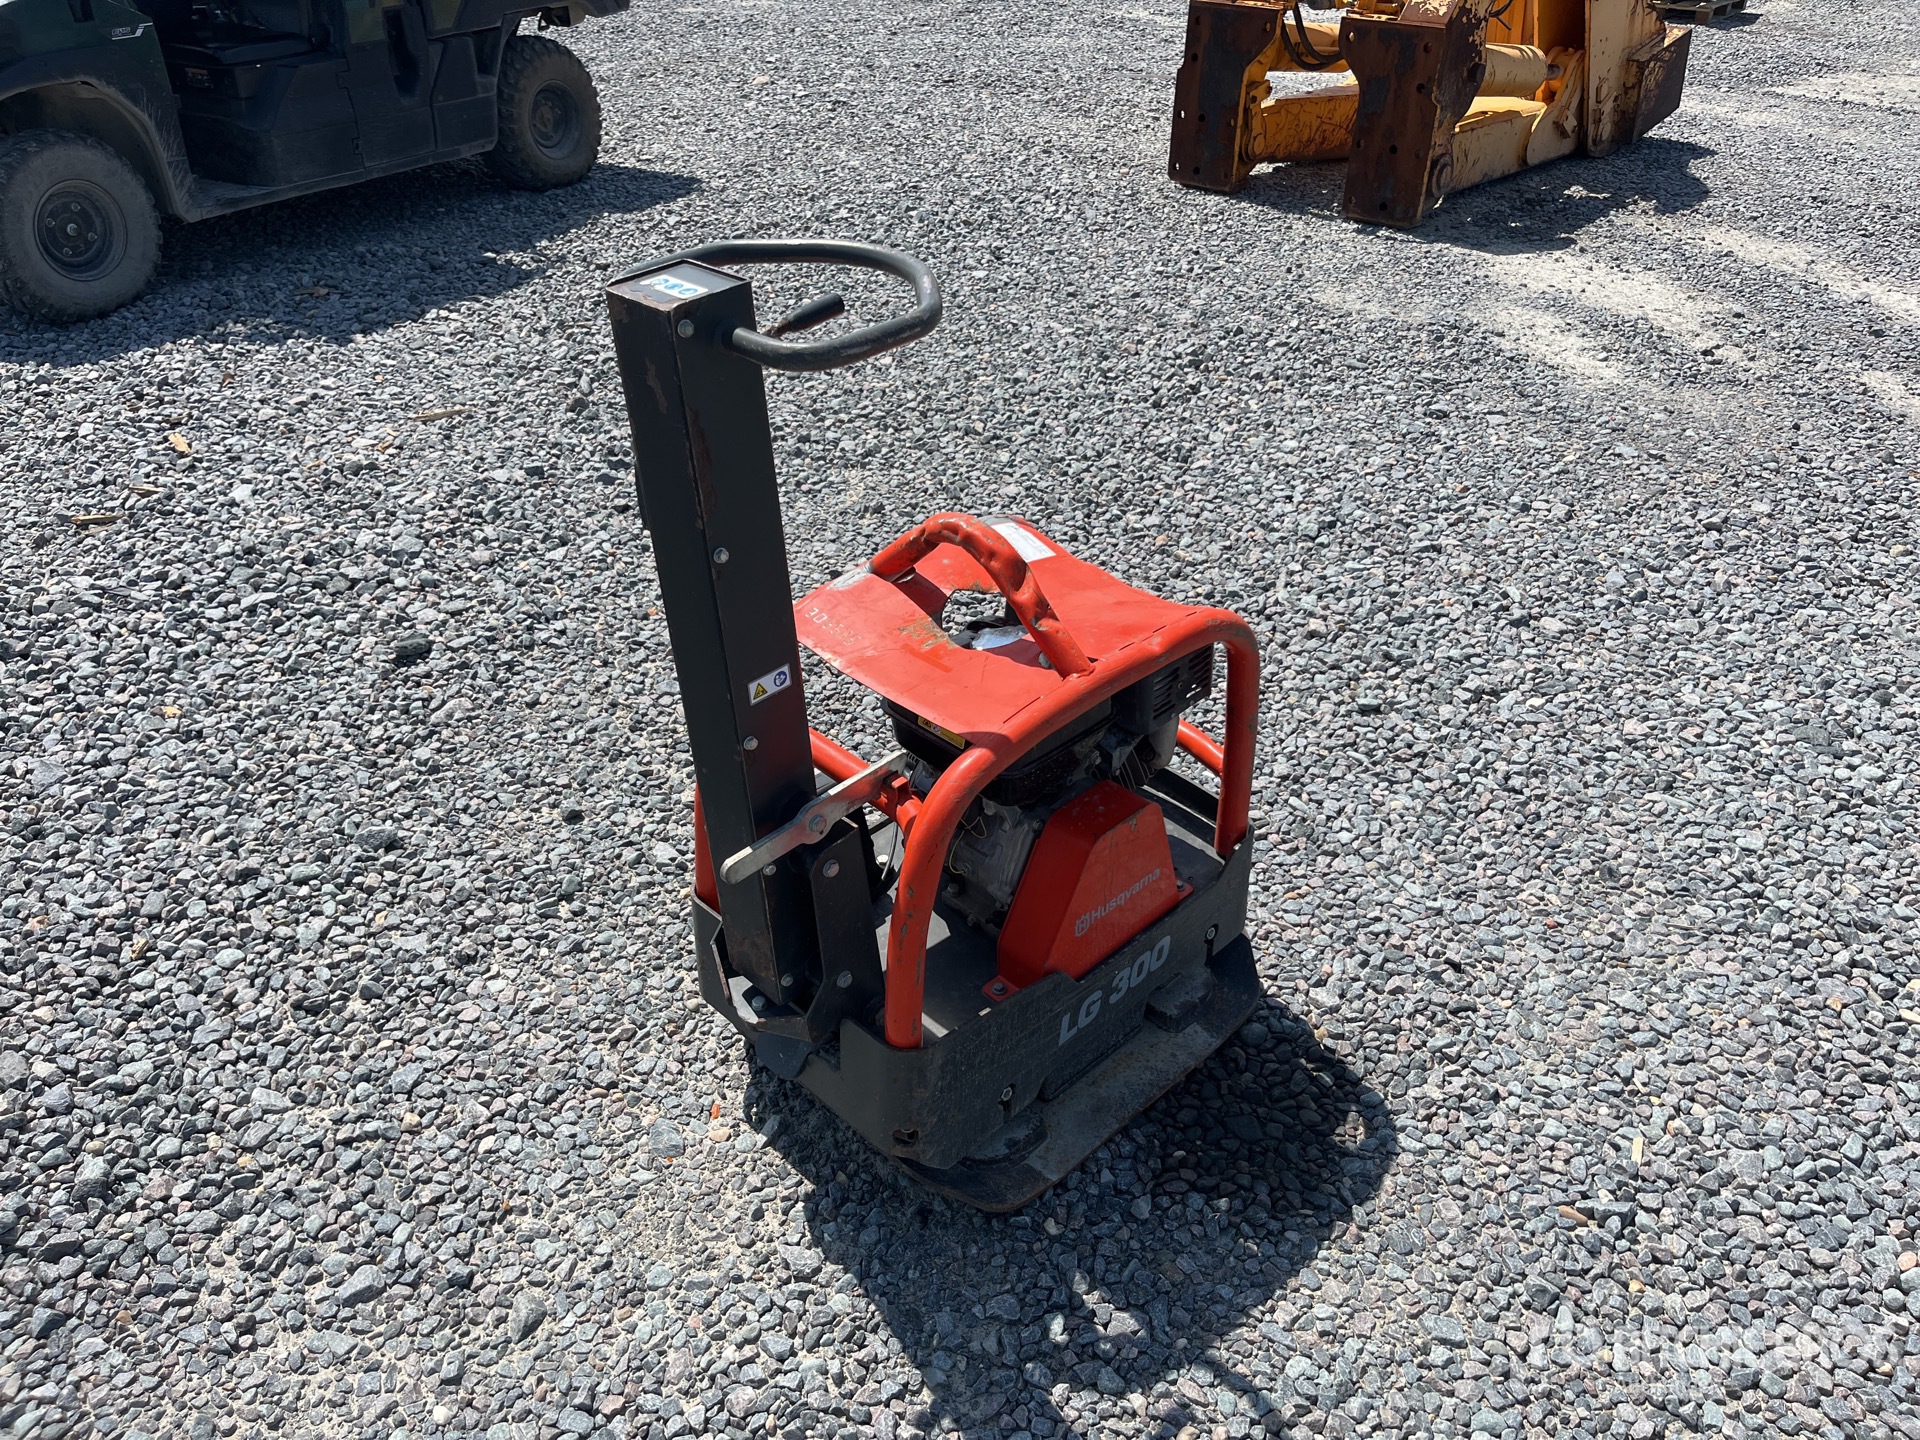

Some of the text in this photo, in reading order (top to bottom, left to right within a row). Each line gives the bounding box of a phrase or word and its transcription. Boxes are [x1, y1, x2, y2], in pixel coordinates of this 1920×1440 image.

[1090, 868, 1161, 923] Husqvarna
[1058, 935, 1171, 1047] LG 300
